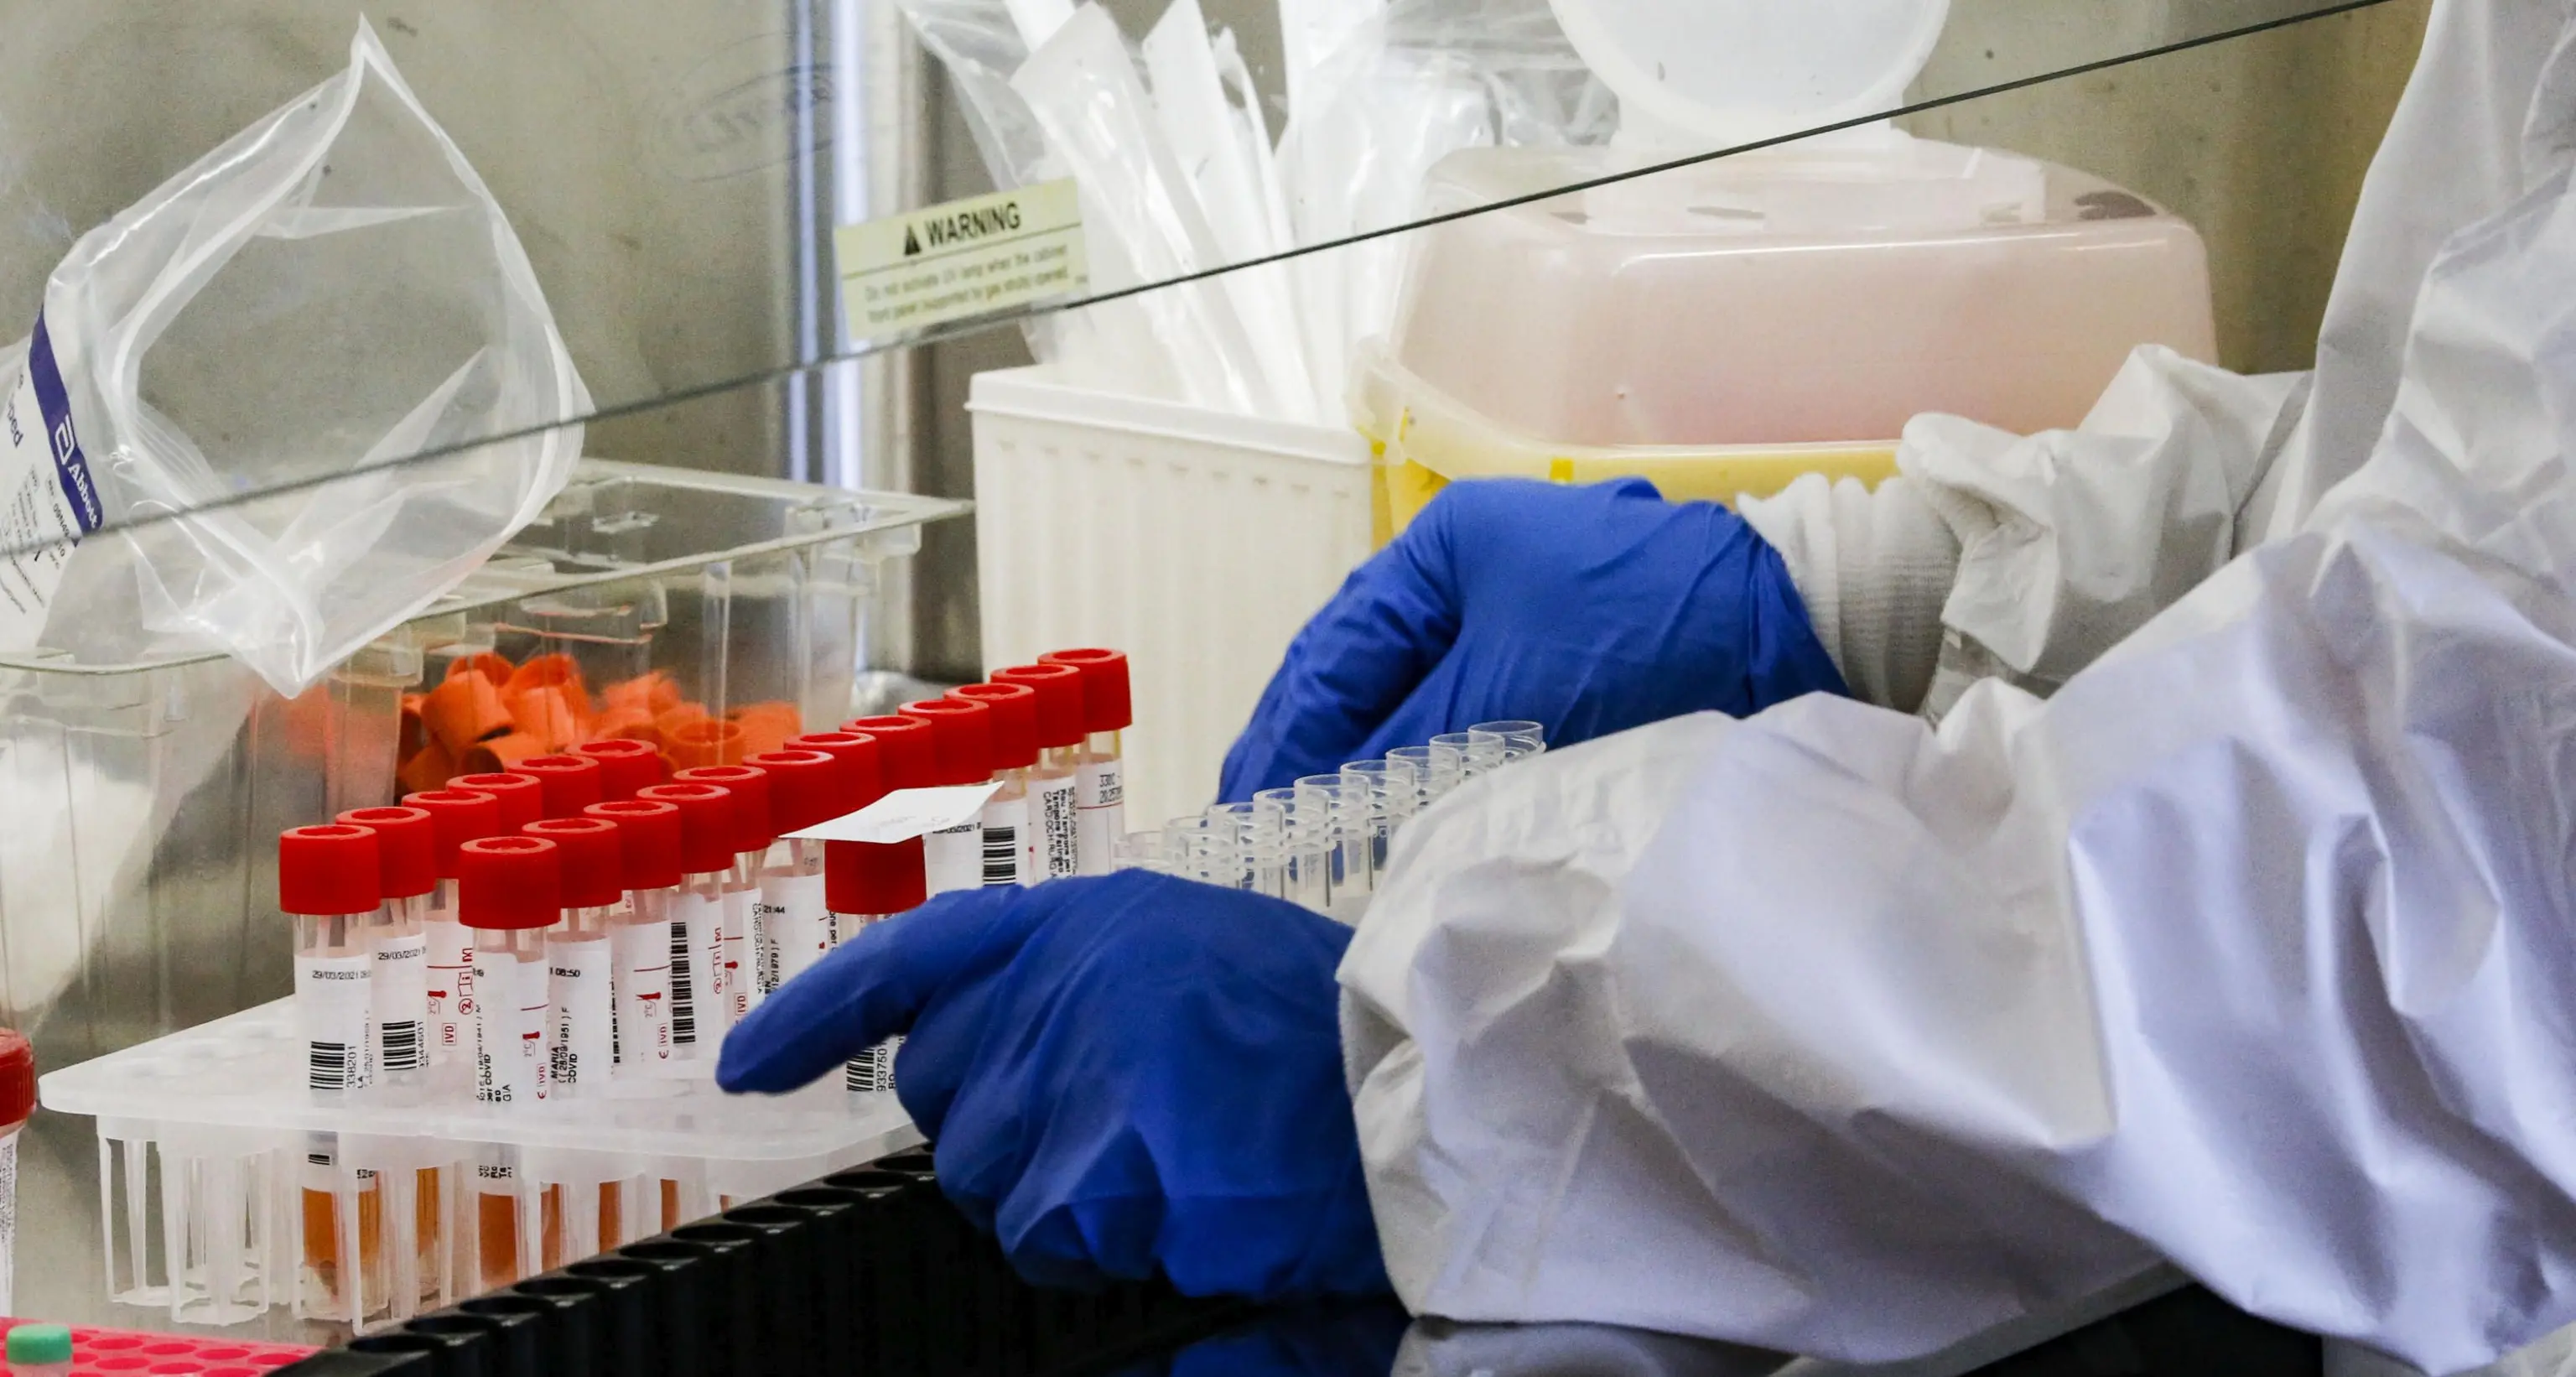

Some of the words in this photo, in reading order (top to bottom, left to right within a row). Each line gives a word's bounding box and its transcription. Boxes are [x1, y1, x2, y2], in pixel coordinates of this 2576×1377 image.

[927, 202, 1021, 247] WARNING
[68, 465, 97, 528] Abbott
[1052, 790, 1061, 831] Tampone
[378, 948, 422, 960] 29/03/2021
[312, 969, 359, 980] 29/03/2021
[555, 968, 580, 978] 08:50
[736, 995, 745, 1013] IVD
[444, 1026, 454, 1044] IVD
[346, 1046, 356, 1088] 338201
[483, 1053, 492, 1085] COVID
[550, 1046, 559, 1079] MARIA
[568, 1052, 577, 1083] COVID
[877, 1042, 887, 1091] 933750
